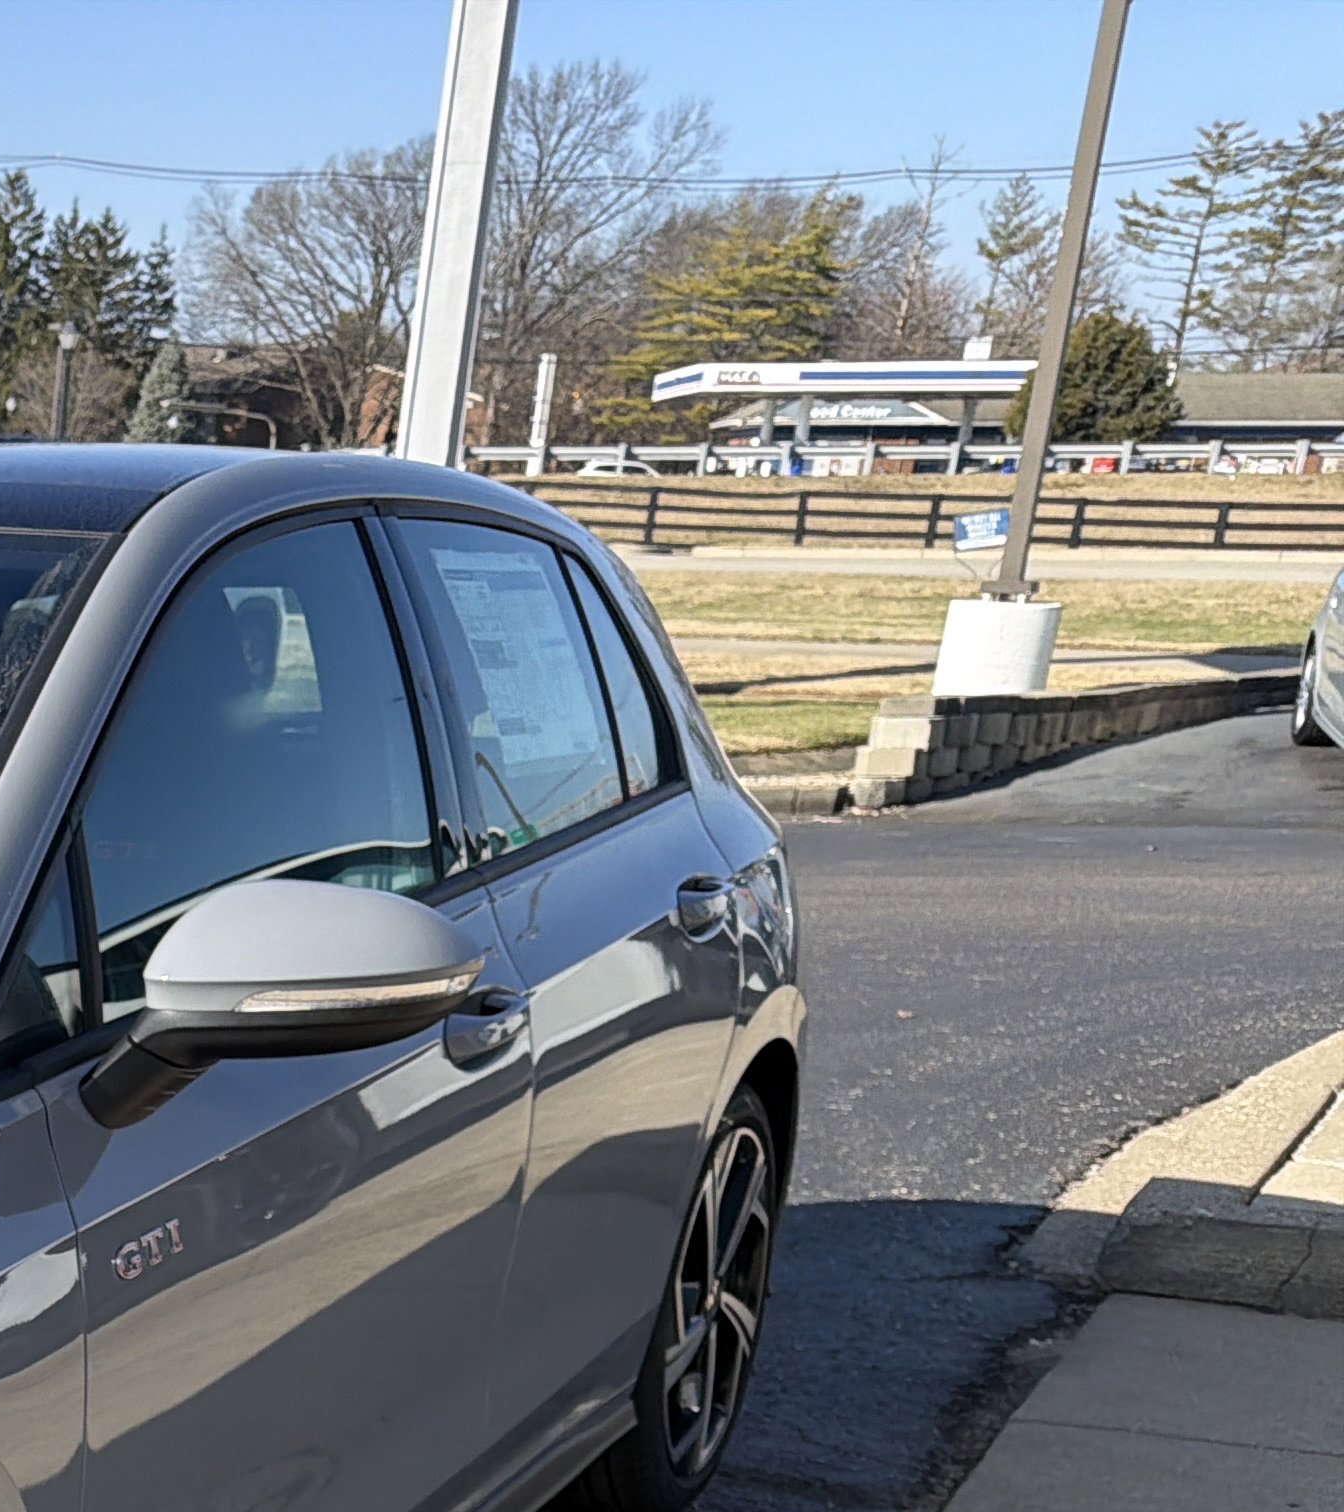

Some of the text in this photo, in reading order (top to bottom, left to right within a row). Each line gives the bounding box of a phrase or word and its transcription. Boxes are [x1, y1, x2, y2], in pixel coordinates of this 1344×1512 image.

[810, 404, 892, 418] ood Center
[113, 1217, 185, 1281] GTI
